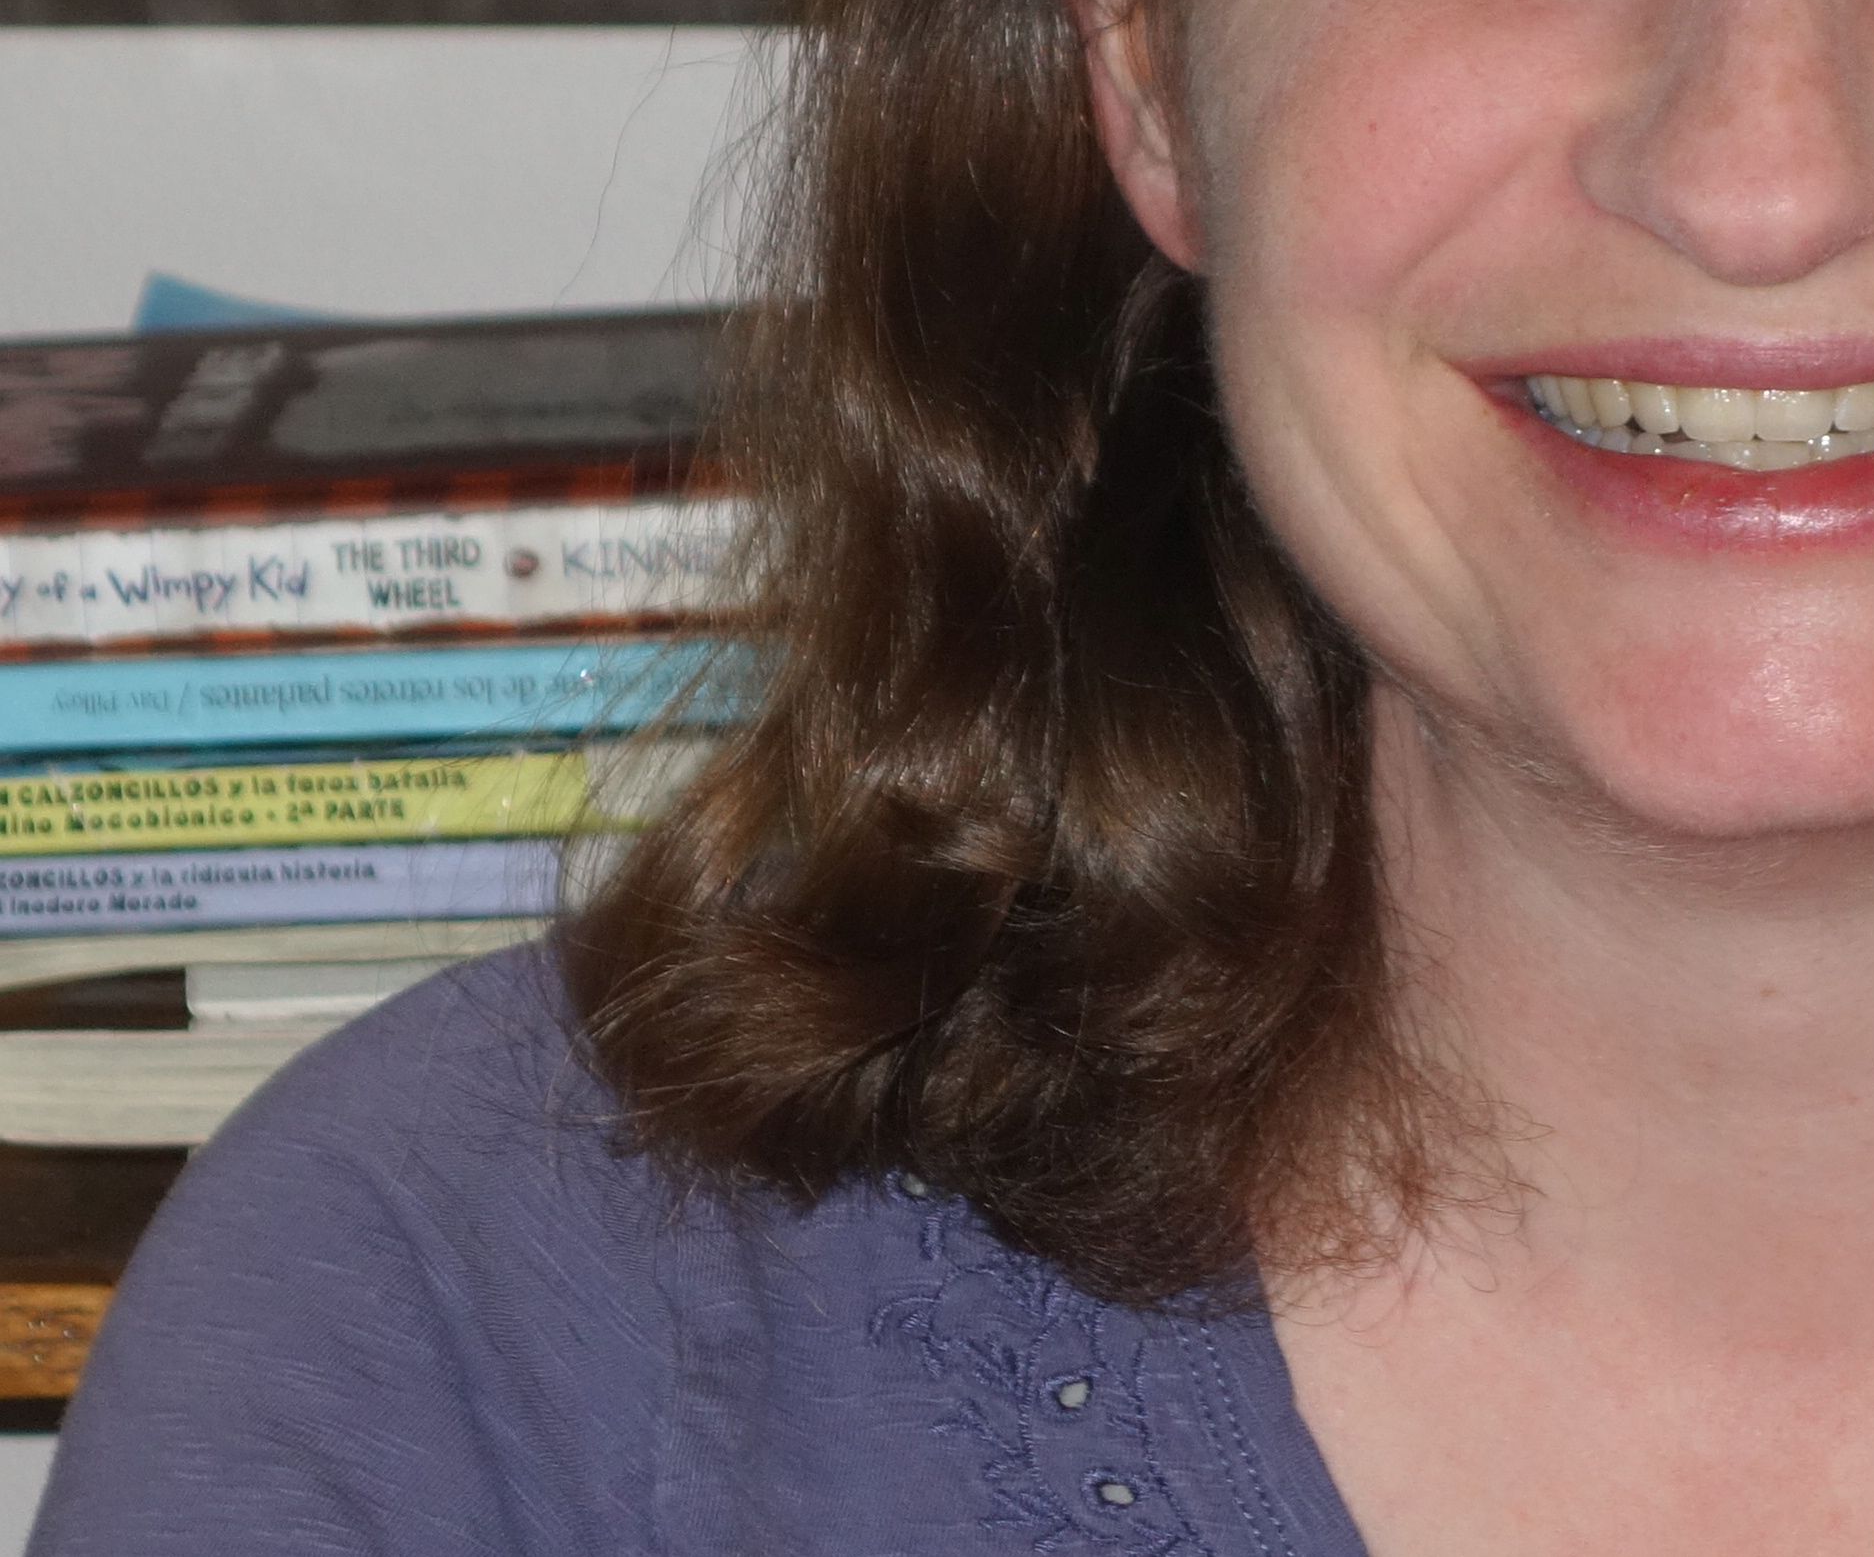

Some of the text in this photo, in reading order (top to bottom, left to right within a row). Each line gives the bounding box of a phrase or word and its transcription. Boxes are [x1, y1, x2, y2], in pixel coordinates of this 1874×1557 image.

[331, 536, 482, 574] THE THIRD
[561, 535, 728, 580] KINNE
[37, 570, 69, 603] of
[106, 562, 237, 614] Wimpy
[248, 552, 310, 601] Kid
[368, 577, 462, 610] WHEEL
[52, 689, 118, 716] Pilkey
[199, 673, 331, 715] parlantes
[338, 676, 444, 709] retretes
[452, 672, 493, 705] los
[17, 776, 219, 807] CALZONCILLOS
[251, 774, 276, 796] la
[286, 772, 359, 794] feroz
[367, 769, 467, 791] batalla
[323, 796, 405, 821] PARTE
[152, 865, 174, 885] la
[281, 857, 377, 881] historia
[10, 895, 100, 916] Inodoro
[109, 891, 198, 912] Morado
